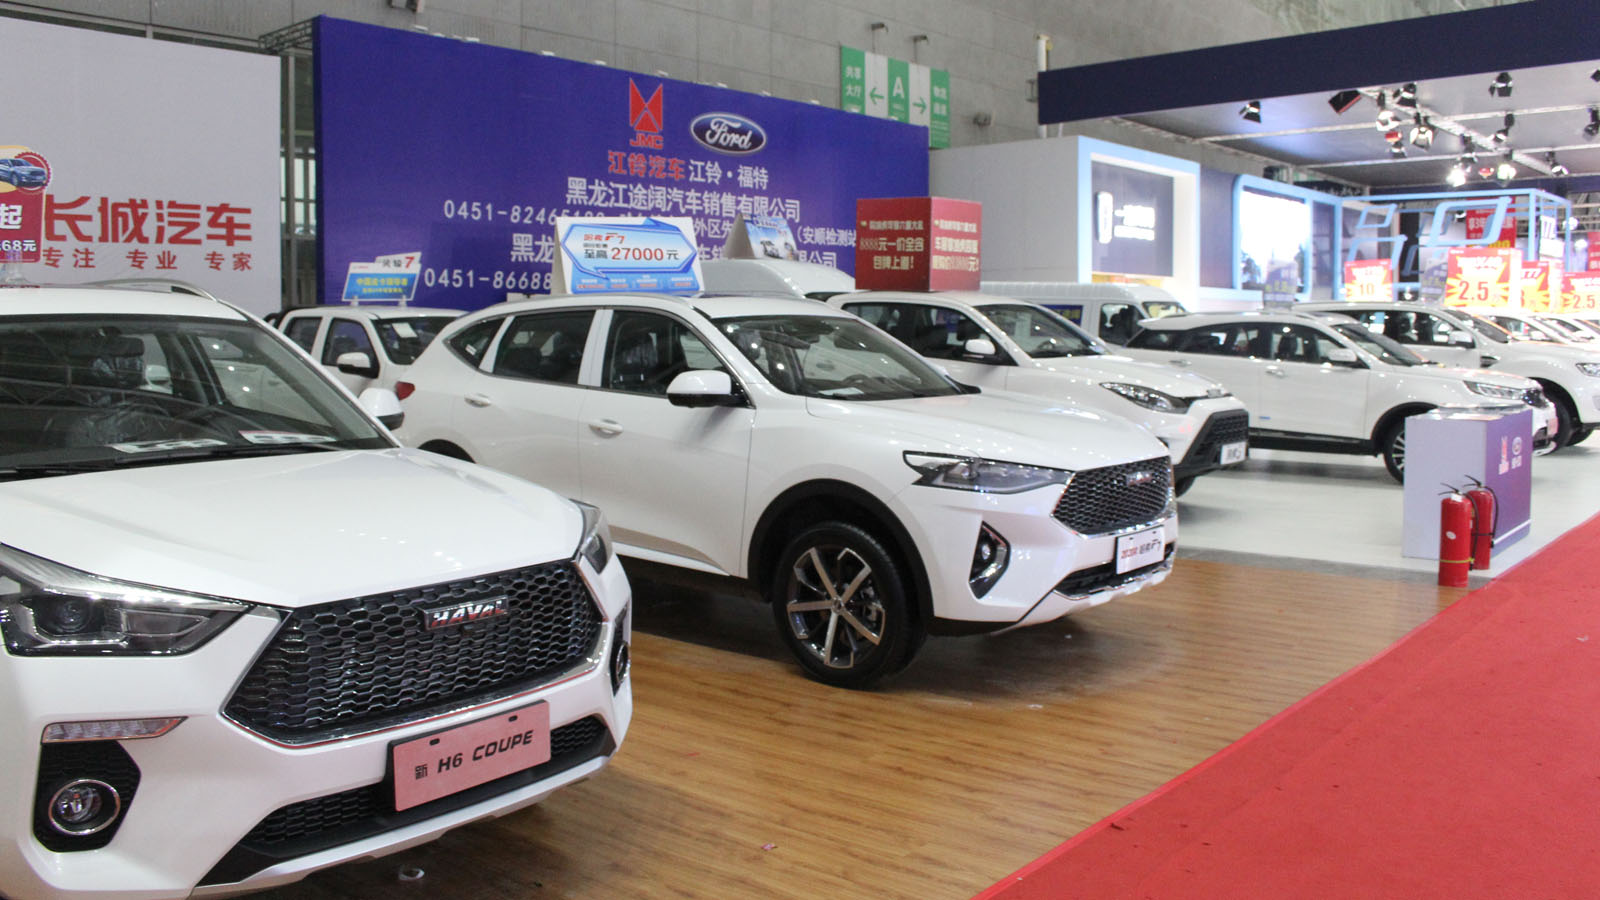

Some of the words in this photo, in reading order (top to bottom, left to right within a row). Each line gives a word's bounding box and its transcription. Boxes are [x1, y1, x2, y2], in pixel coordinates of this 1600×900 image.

[892, 77, 905, 99] A
[630, 133, 664, 149] JMC
[704, 118, 753, 150] Ford
[608, 150, 685, 180] 江铃汽车
[566, 176, 801, 223] 黑龙江途阔汽车销售有限公司
[0, 203, 23, 229] 起
[45, 194, 252, 246] 长城汽车
[43, 247, 96, 269] 专注
[126, 250, 178, 270] 专业
[204, 251, 252, 271] 专家
[1458, 280, 1489, 301] 2.5
[430, 599, 507, 628] HAVAL
[414, 763, 428, 780] 新
[437, 753, 463, 774] H6
[472, 729, 534, 762] COUPE
